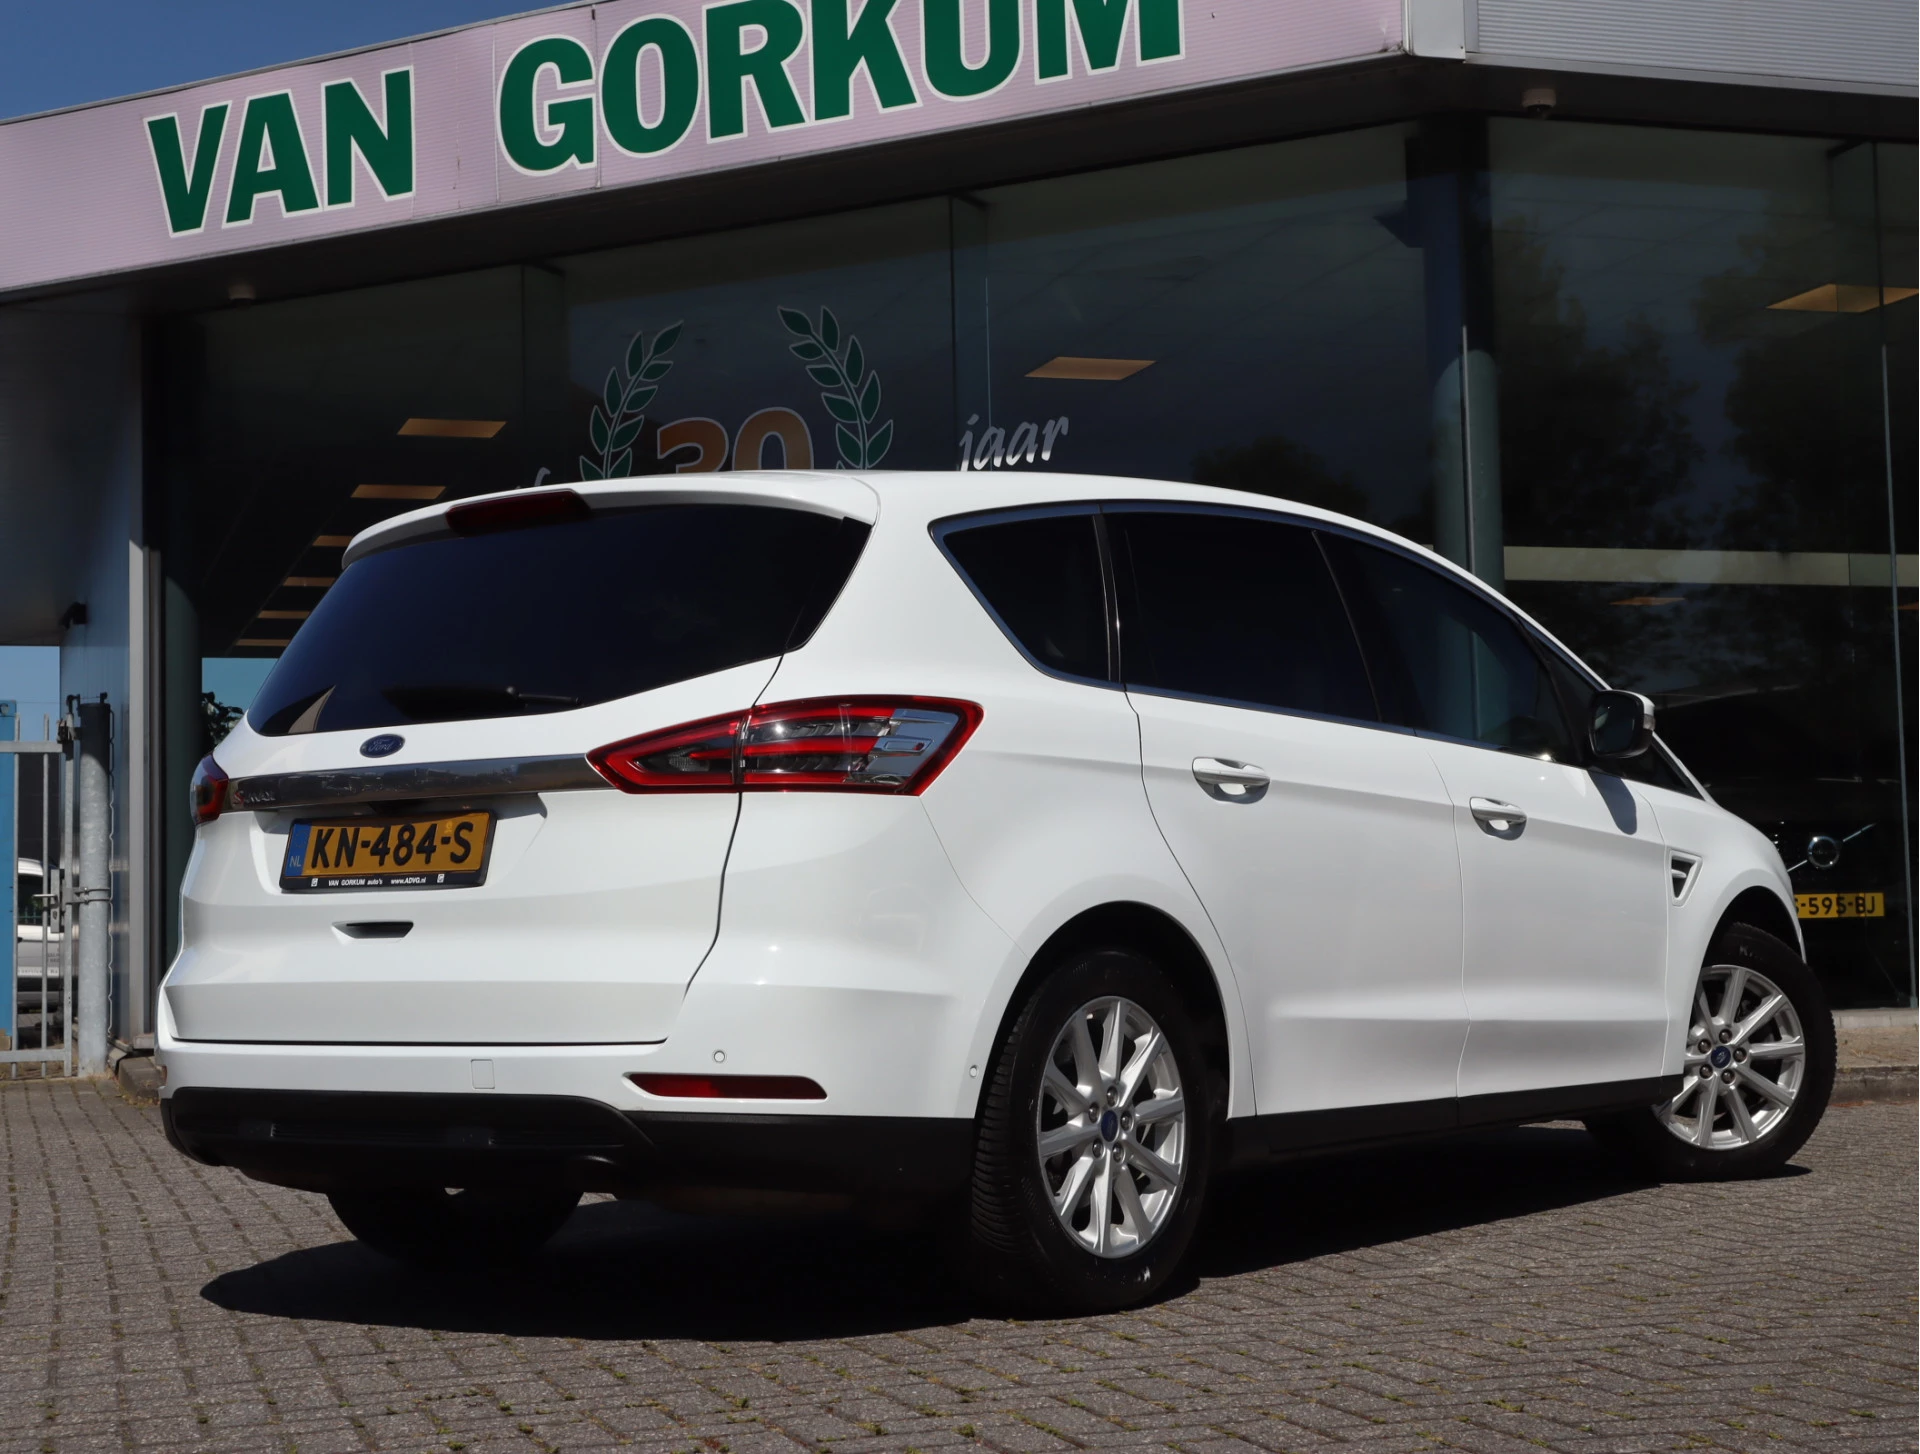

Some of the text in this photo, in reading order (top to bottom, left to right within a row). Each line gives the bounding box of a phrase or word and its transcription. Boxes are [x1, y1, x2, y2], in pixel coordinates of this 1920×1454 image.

[144, 66, 415, 237] VAN
[959, 413, 1069, 472] jaar
[289, 855, 302, 868] NL
[311, 821, 474, 869] KN-484-S
[341, 878, 365, 886] GORKUM
[391, 876, 426, 884] www.ADVG.nl
